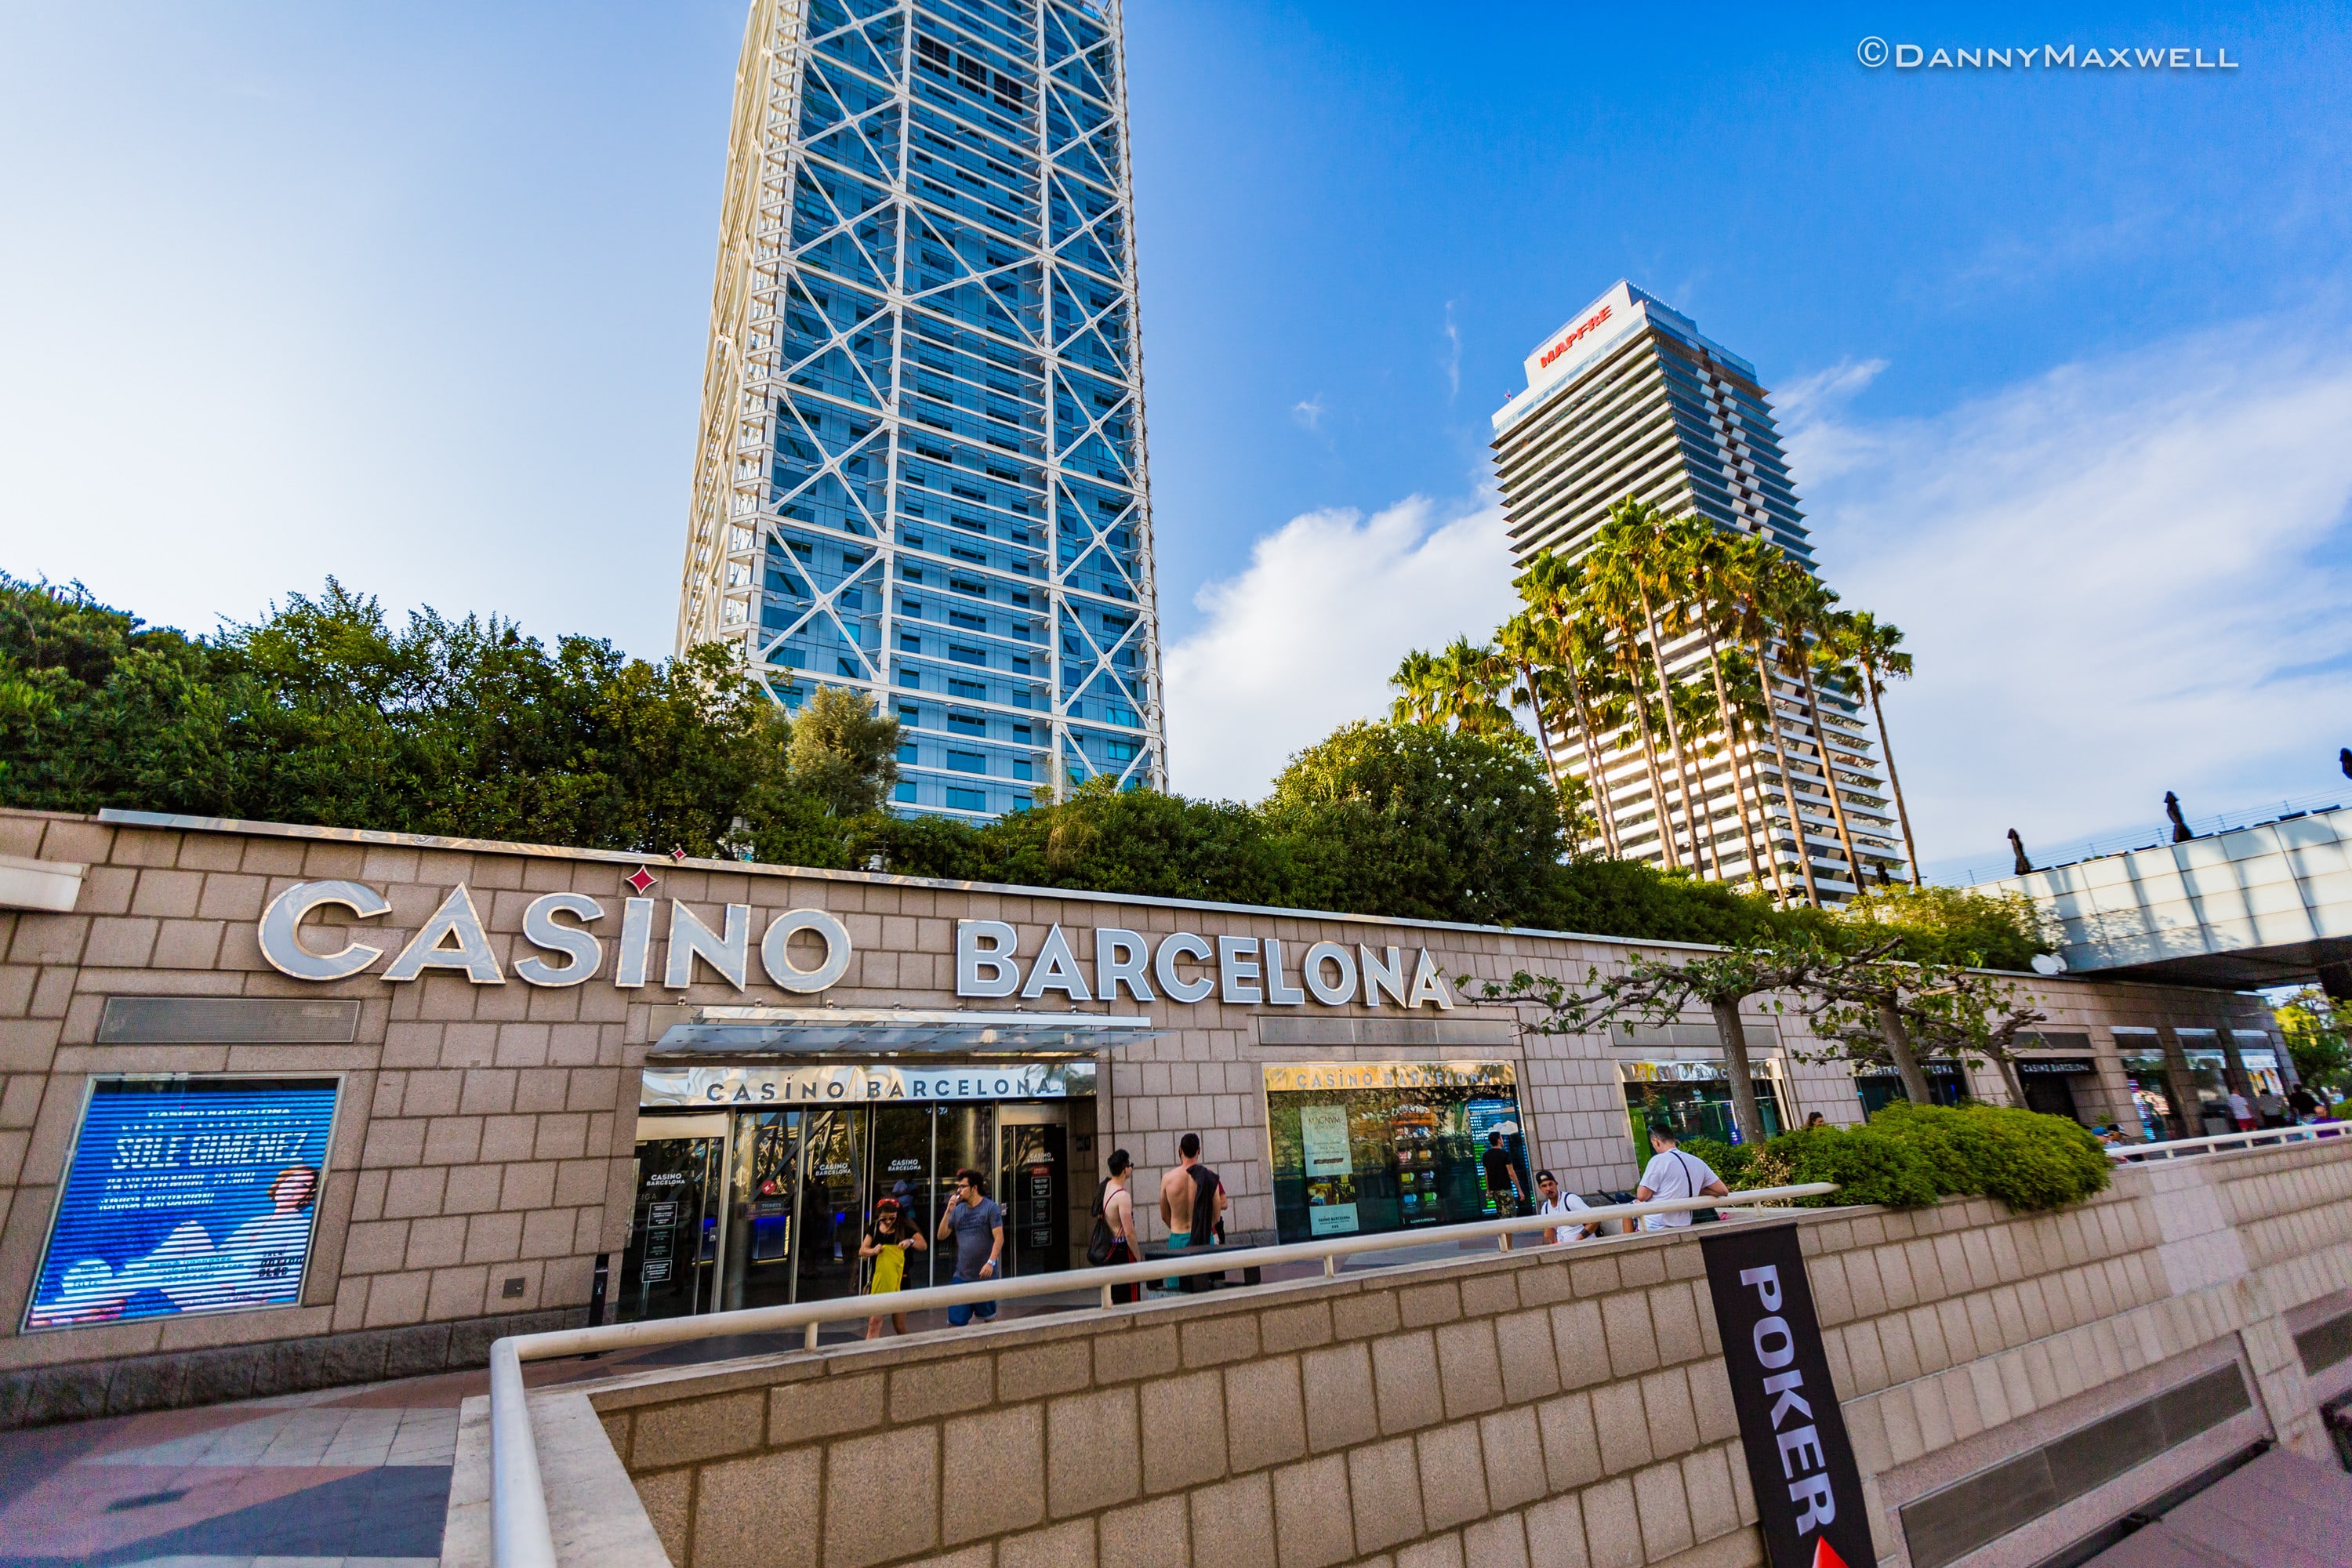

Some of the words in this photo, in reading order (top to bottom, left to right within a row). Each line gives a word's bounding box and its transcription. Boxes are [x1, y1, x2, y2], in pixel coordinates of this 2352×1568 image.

[1541, 304, 1613, 368] MAPFRE
[258, 864, 852, 993] CASINO
[956, 918, 1454, 1011] BARCELONA
[706, 1074, 845, 1102] CASINO
[867, 1077, 1051, 1098] BARCELONA
[1296, 1069, 1373, 1089] CASINO
[1384, 1071, 1491, 1087] BARCELONA
[651, 1172, 682, 1181] CASINO
[815, 1167, 852, 1176] BARCELONA
[819, 1162, 849, 1171] CASINO
[646, 1178, 686, 1187] BARCELONA
[1740, 1265, 1836, 1537] POKER
